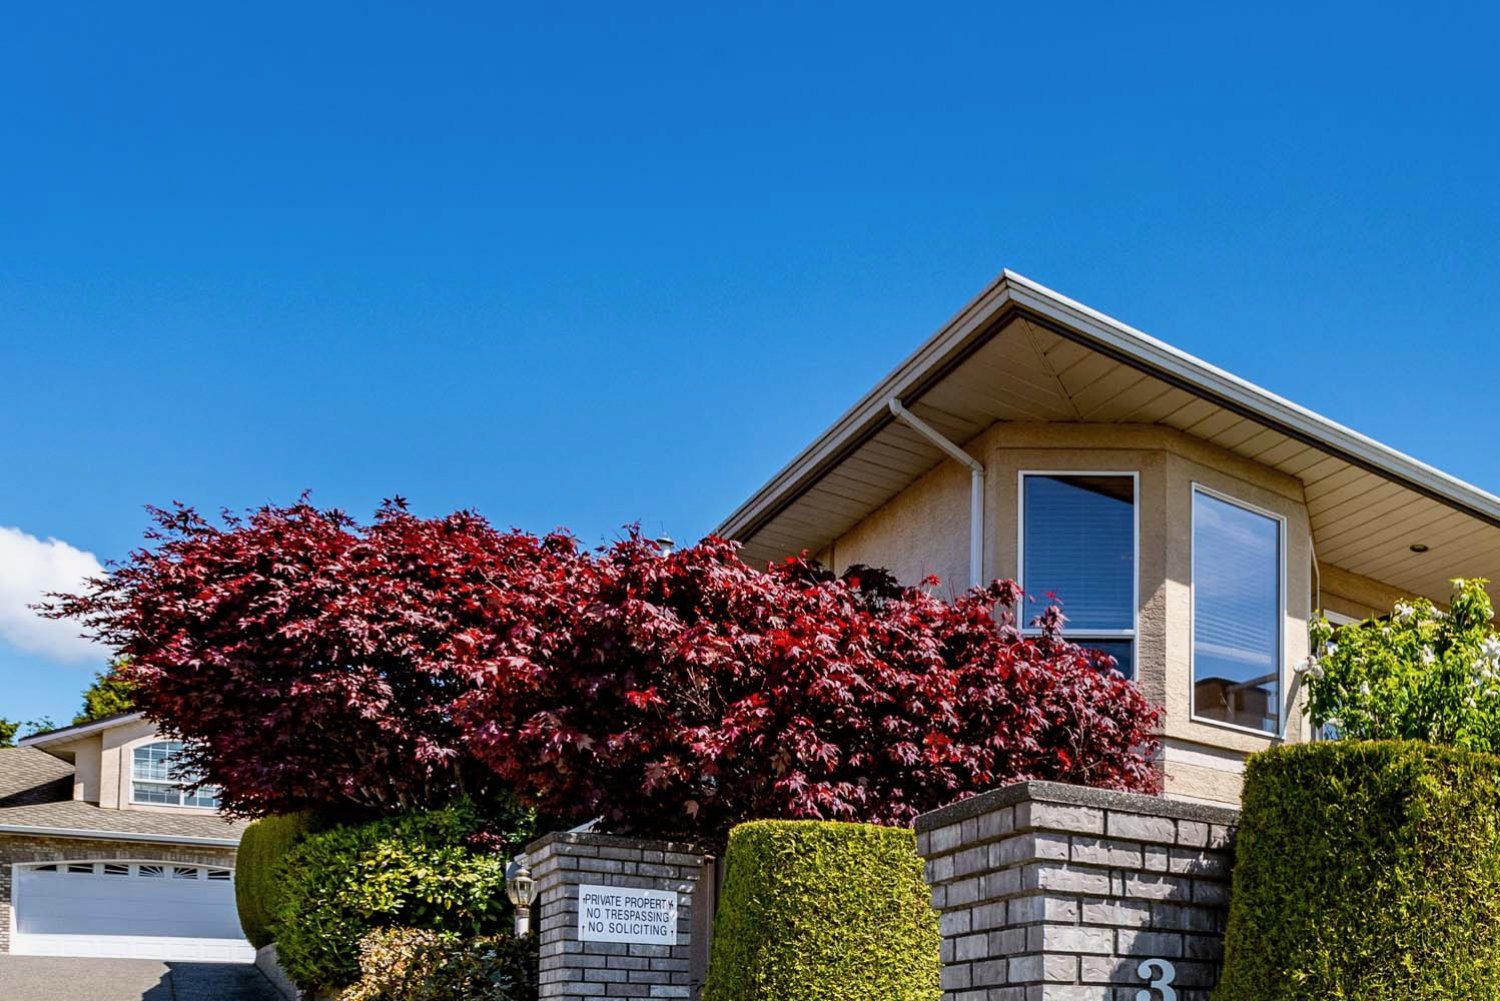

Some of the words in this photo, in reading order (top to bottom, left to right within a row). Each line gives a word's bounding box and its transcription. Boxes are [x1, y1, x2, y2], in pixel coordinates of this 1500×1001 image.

[585, 893, 622, 907] PRIVATE
[624, 896, 674, 910] PROPERTY
[586, 907, 601, 919] NO
[605, 908, 670, 923] TRESPASSING
[588, 921, 604, 933] NO
[608, 922, 668, 936] SOLICITING
